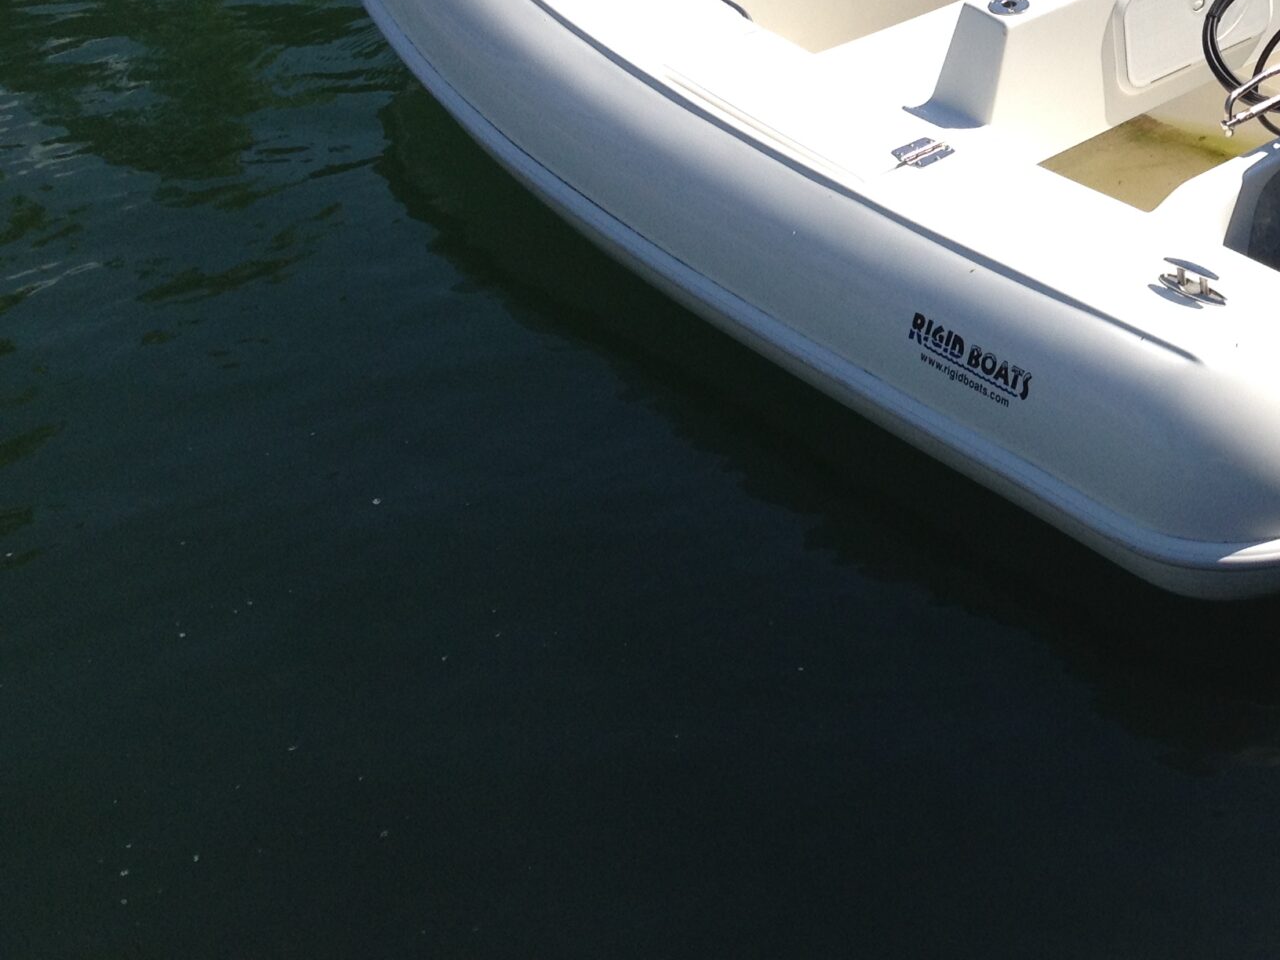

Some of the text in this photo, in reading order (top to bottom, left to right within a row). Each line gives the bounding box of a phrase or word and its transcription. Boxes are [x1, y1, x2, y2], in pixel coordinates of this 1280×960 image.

[908, 312, 1033, 401] RIGID BOATS
[920, 352, 1010, 408] www.rigidboats.com
